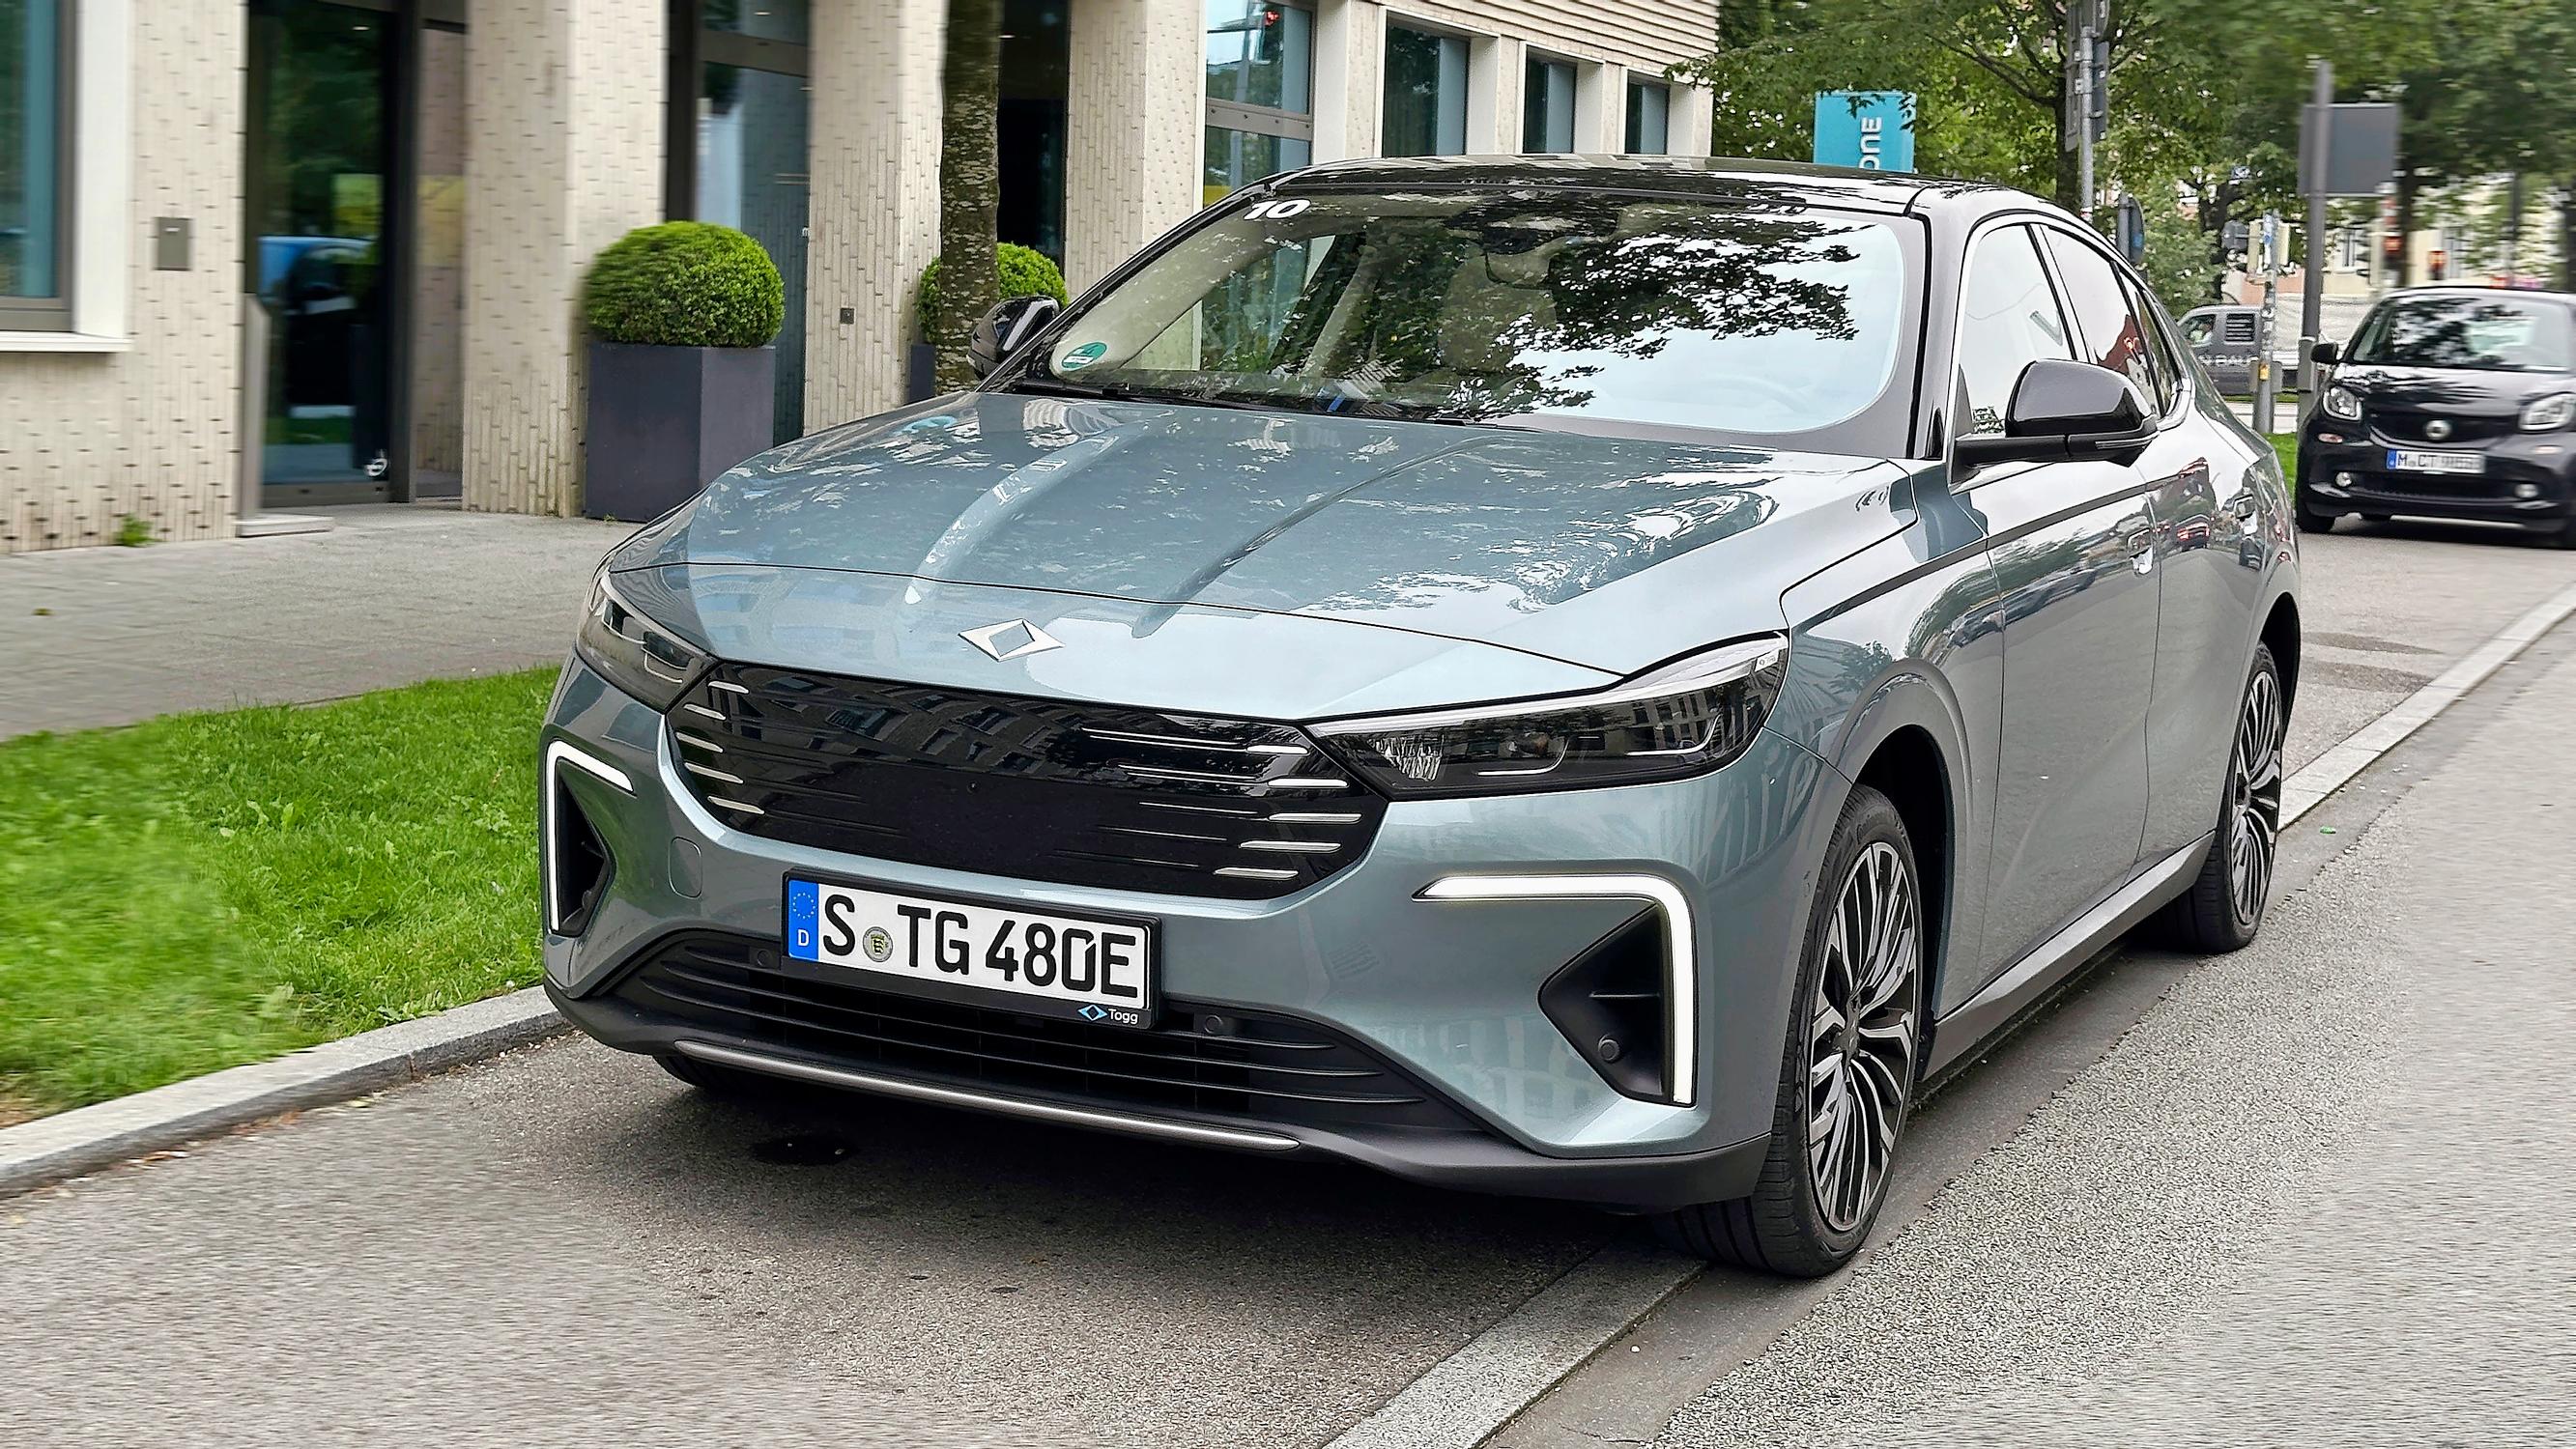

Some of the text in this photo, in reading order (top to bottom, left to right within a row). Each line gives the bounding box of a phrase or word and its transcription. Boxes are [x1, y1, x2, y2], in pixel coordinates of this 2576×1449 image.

[1245, 199, 1311, 220] 10
[2397, 453, 2408, 467] M
[797, 928, 809, 947] D
[822, 894, 1138, 998] S TG 480E
[1107, 1008, 1138, 1024] Togg
